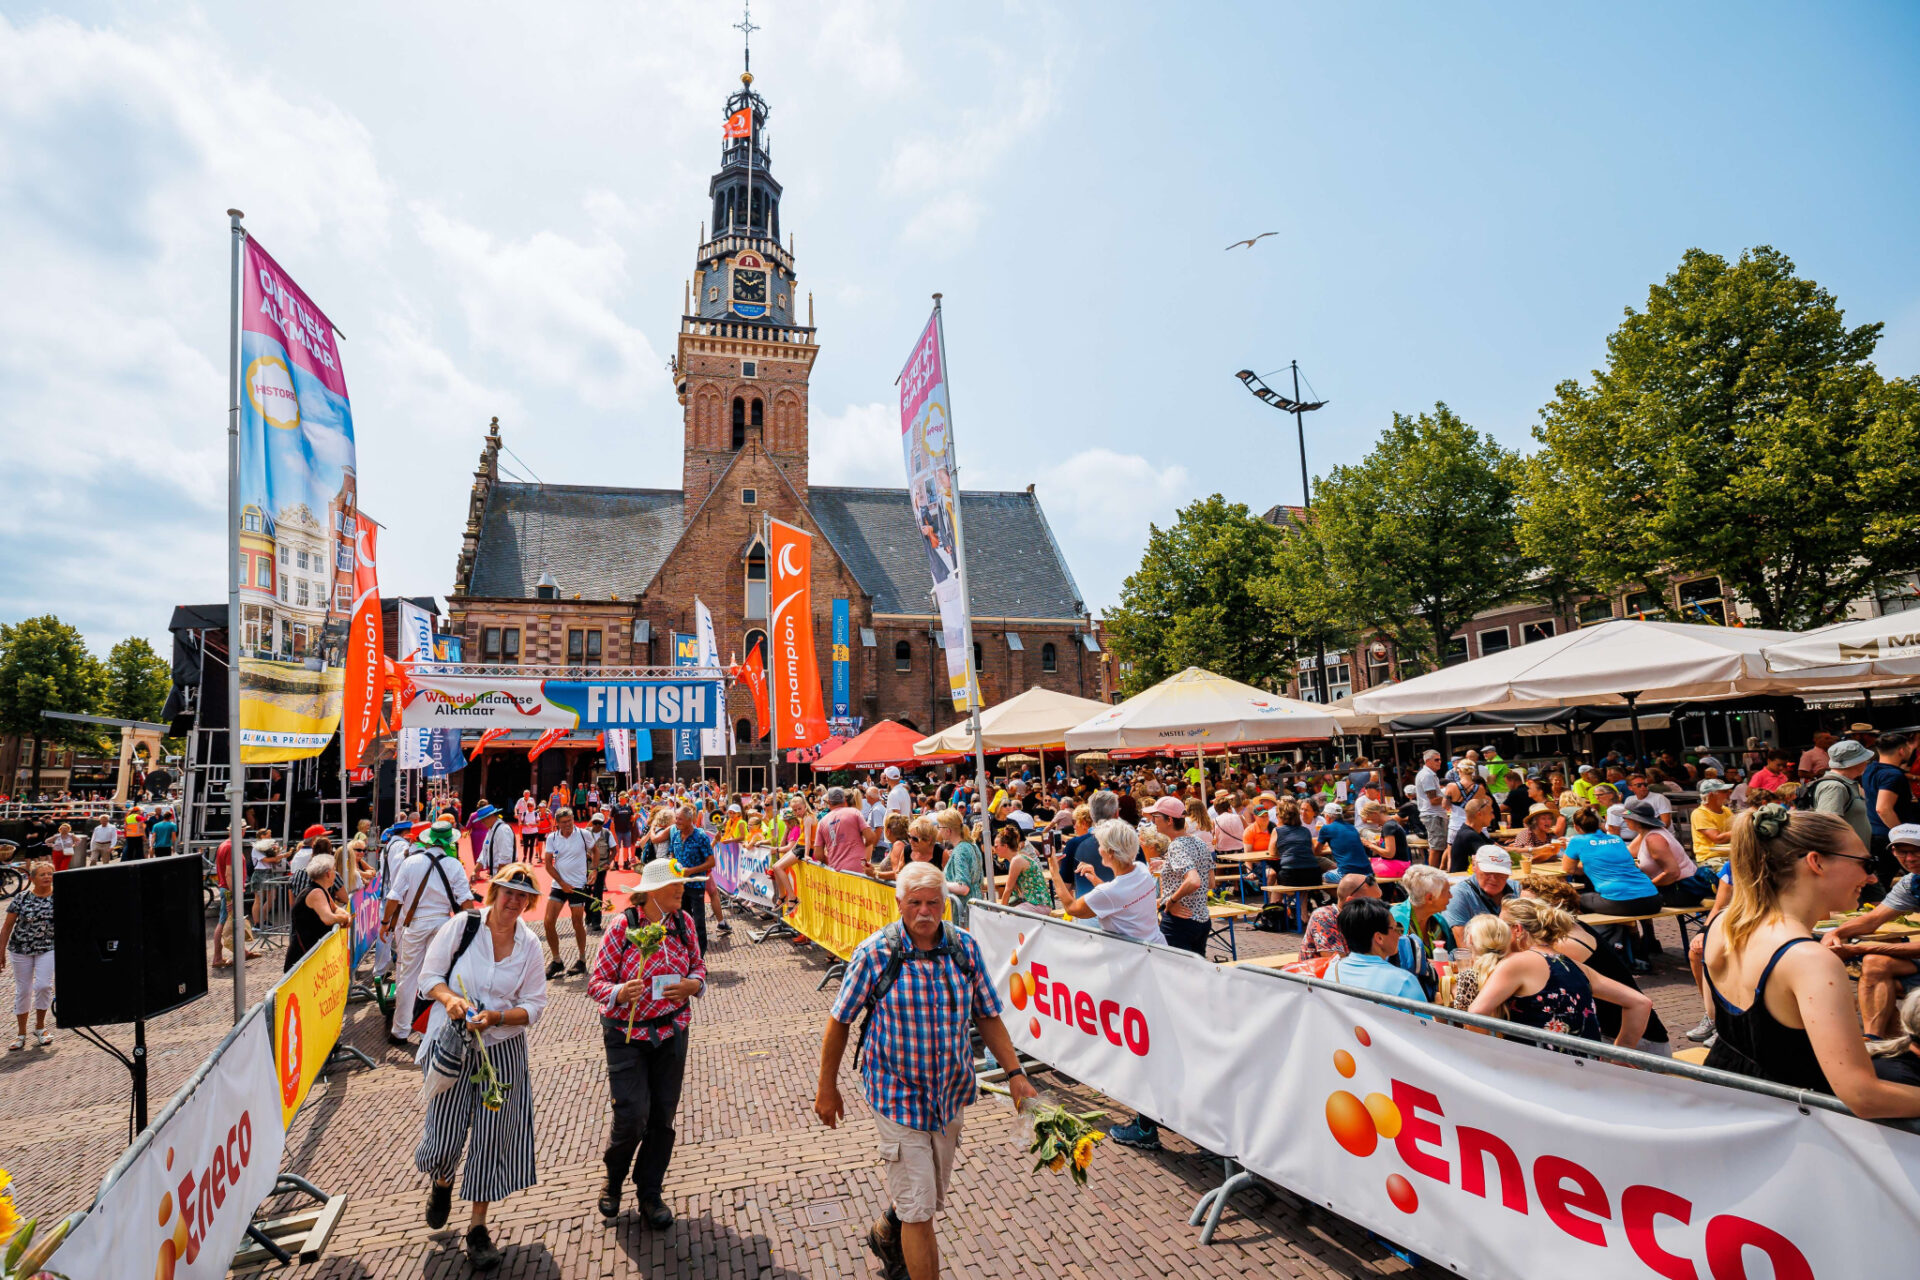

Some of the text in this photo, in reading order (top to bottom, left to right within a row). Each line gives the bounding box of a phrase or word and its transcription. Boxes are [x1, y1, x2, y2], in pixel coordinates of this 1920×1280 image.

[362, 612, 378, 733] Champion
[435, 704, 495, 716] Alkmaar
[587, 686, 705, 723] FINISH
[784, 615, 806, 740] le Champion
[1030, 962, 1150, 1057] Eneco
[178, 1110, 252, 1265] Eneco
[1391, 1078, 1814, 1280] Eneco
